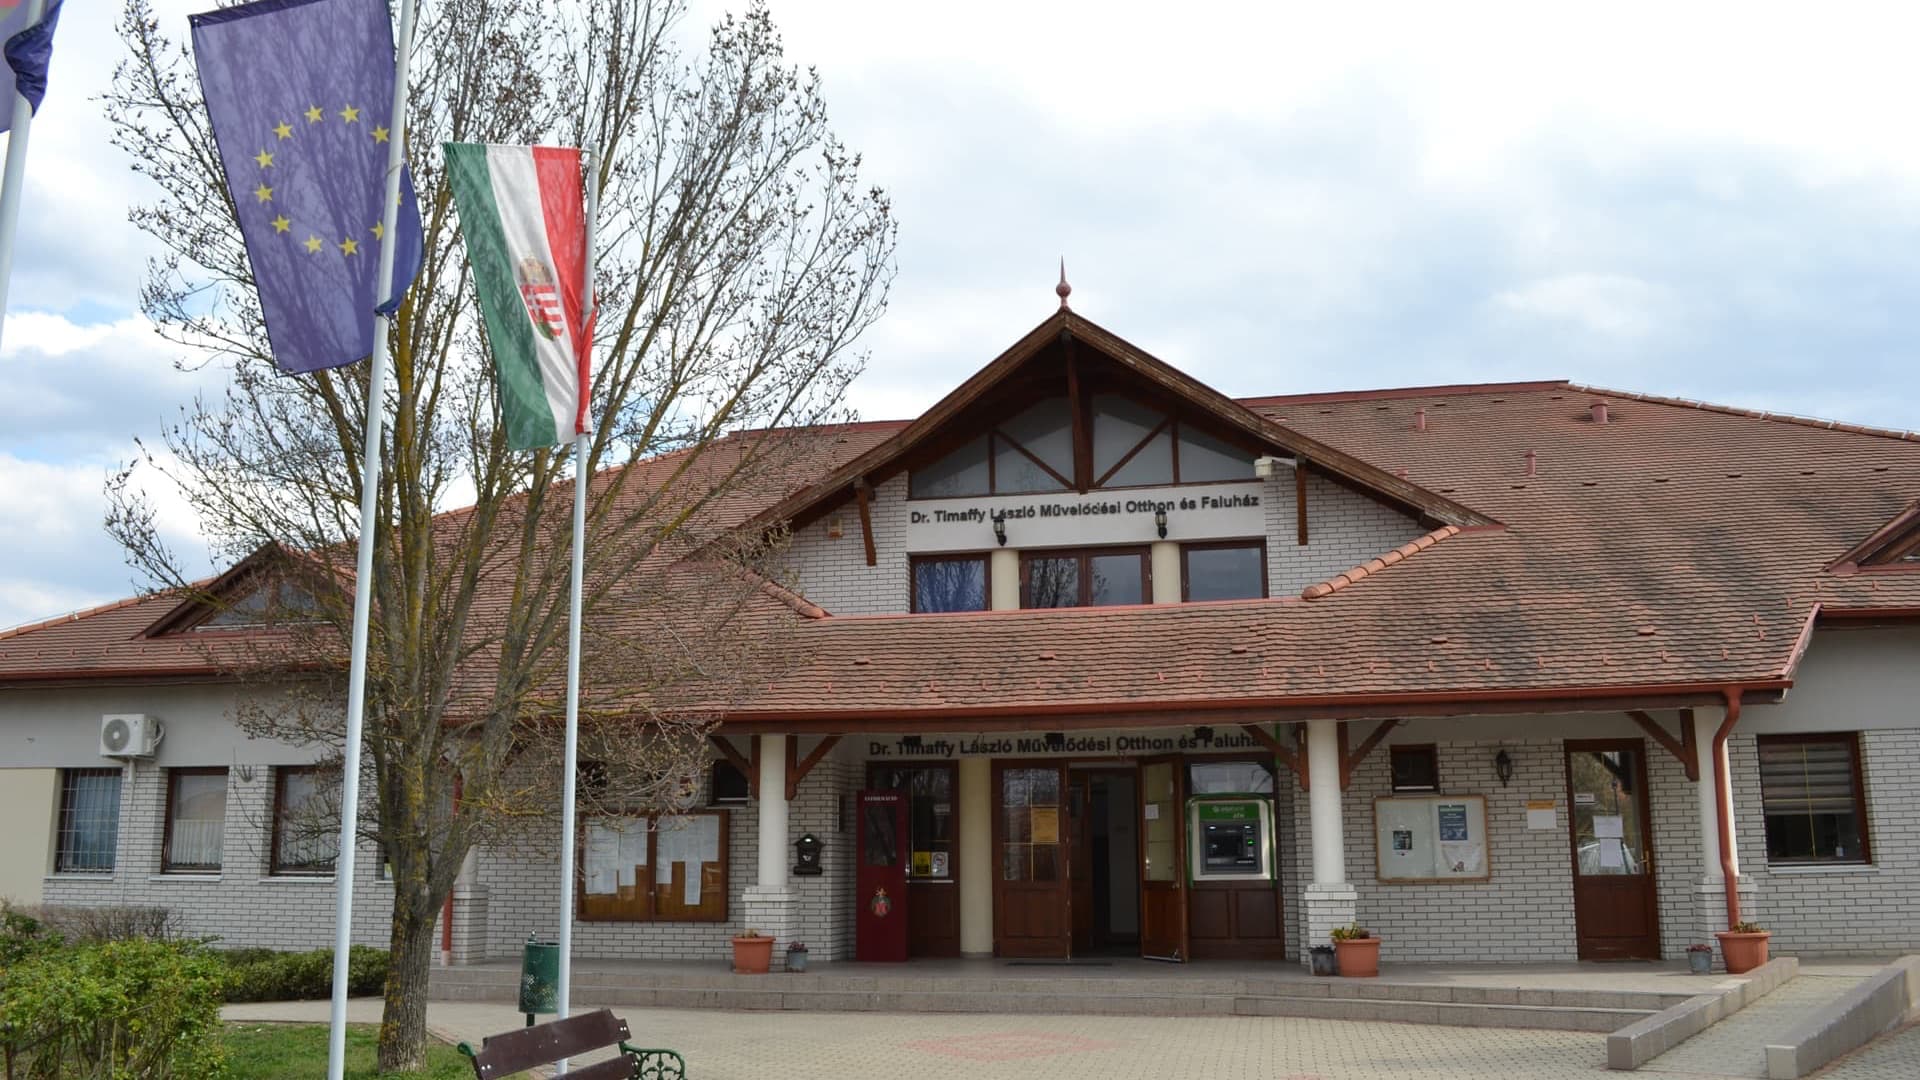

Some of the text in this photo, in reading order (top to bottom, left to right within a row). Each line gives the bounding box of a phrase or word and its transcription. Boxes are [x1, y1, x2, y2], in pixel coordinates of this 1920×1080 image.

[911, 510, 930, 524] Dr.
[934, 508, 985, 524] Timaffy
[990, 505, 1036, 520] László
[1126, 499, 1175, 513] Otthon
[1180, 497, 1196, 510] és
[1201, 494, 1260, 509] Faluház
[868, 741, 891, 756] Dr.
[959, 738, 1012, 754] László
[1116, 735, 1174, 750] Otthon
[1179, 734, 1198, 748] és
